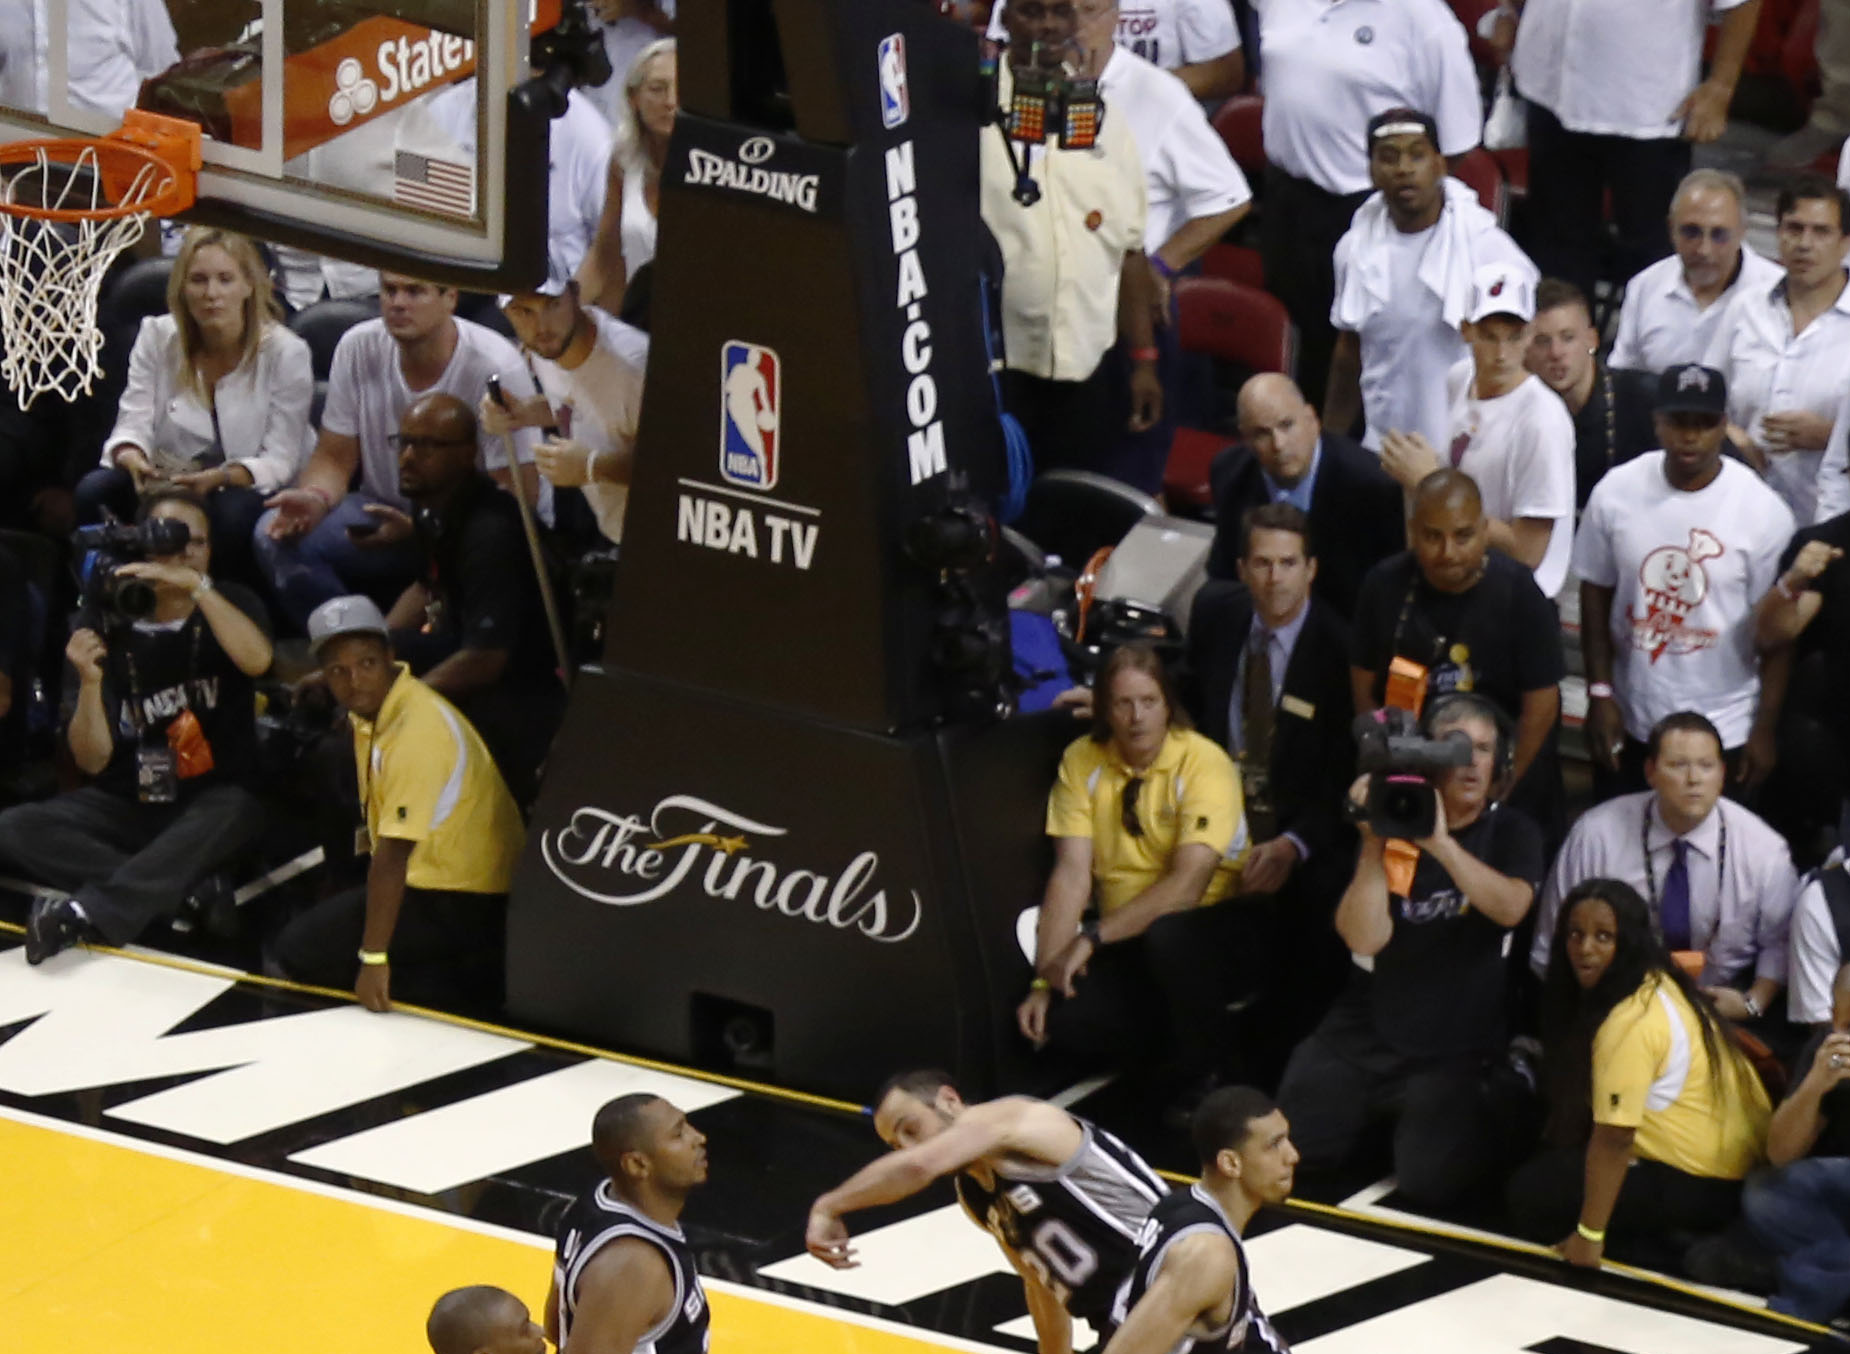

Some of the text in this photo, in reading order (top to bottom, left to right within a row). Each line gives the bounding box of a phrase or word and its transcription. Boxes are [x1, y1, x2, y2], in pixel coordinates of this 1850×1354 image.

[684, 148, 820, 213] SPALDING
[884, 140, 948, 486] NBA.COM
[727, 451, 760, 479] NBA
[677, 494, 819, 571] NBA TV
[541, 795, 921, 944] The Finals
